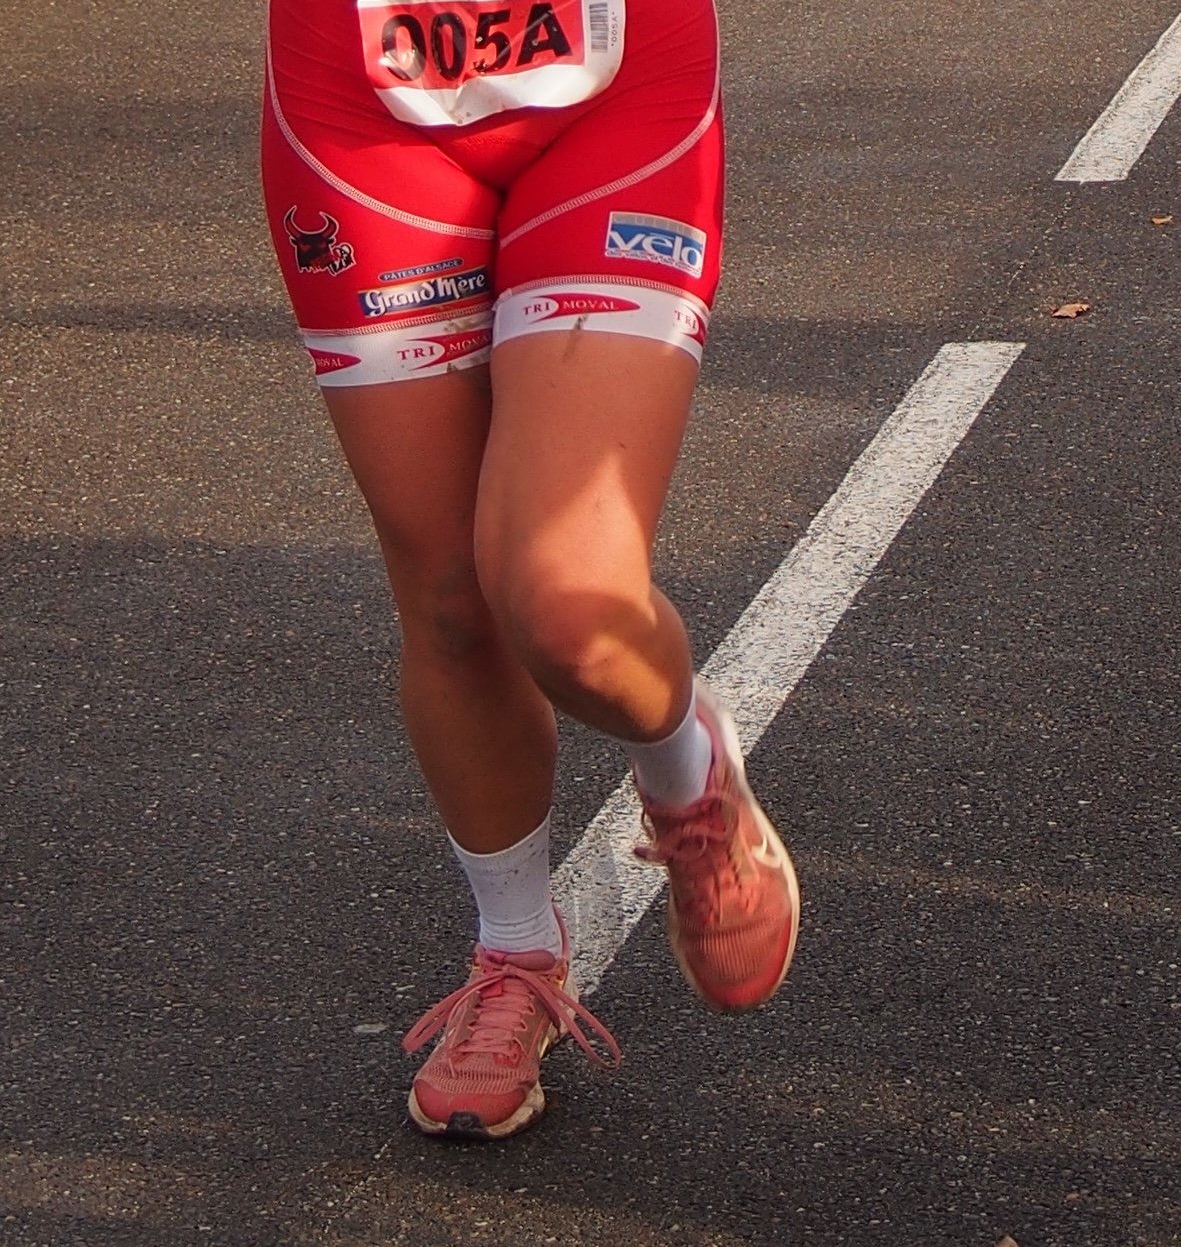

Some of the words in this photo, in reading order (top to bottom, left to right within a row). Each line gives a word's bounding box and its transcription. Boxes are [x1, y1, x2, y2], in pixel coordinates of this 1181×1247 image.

[381, 2, 573, 82] 005A
[523, 301, 551, 315] TRI
[563, 300, 619, 310] MOVAL
[674, 310, 698, 330] TRI
[397, 347, 435, 361] TRI
[449, 335, 494, 353] MOVA
